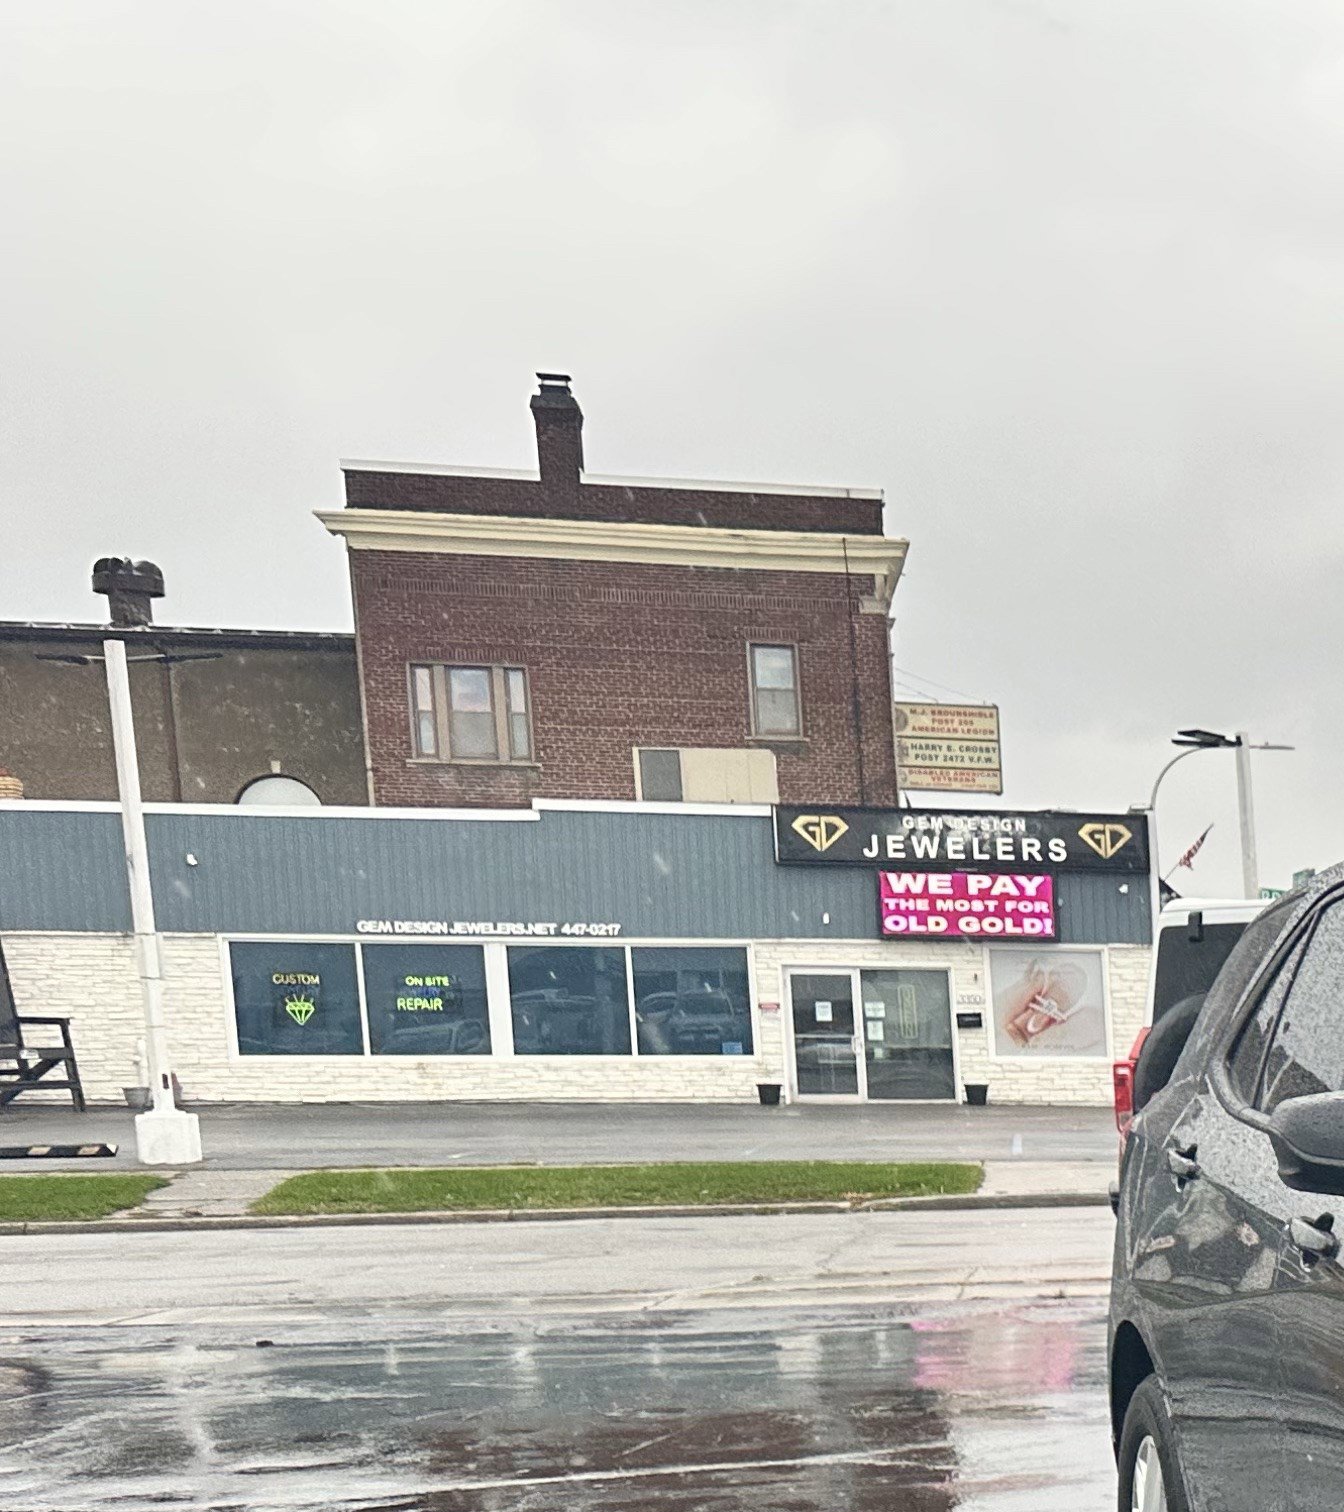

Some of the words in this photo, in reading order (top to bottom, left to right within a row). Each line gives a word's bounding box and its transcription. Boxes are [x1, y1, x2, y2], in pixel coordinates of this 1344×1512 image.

[911, 725, 959, 734] AMERICAN
[961, 727, 995, 736] LEGION
[910, 743, 943, 752] HARRY
[958, 744, 997, 754] CROSBY
[914, 753, 939, 761] POST
[943, 754, 965, 762] 2472
[902, 815, 943, 831] GEM
[954, 817, 1027, 833] DESIGN
[862, 834, 1068, 862] JEWELERS
[886, 872, 953, 895] WE
[967, 874, 1045, 897] PAY
[884, 897, 930, 912] THE
[936, 898, 999, 913] MOST
[1005, 900, 1049, 914] FOR
[356, 919, 393, 934] GEM
[394, 920, 448, 934] DESIGN
[449, 921, 556, 936] JEWELERS.NET
[884, 915, 948, 933] OLD
[958, 916, 1053, 935] GOLD!
[272, 973, 320, 985] CUSTOM
[405, 975, 423, 987] ON
[425, 975, 450, 987] SITE
[397, 998, 443, 1011] REPAIR
